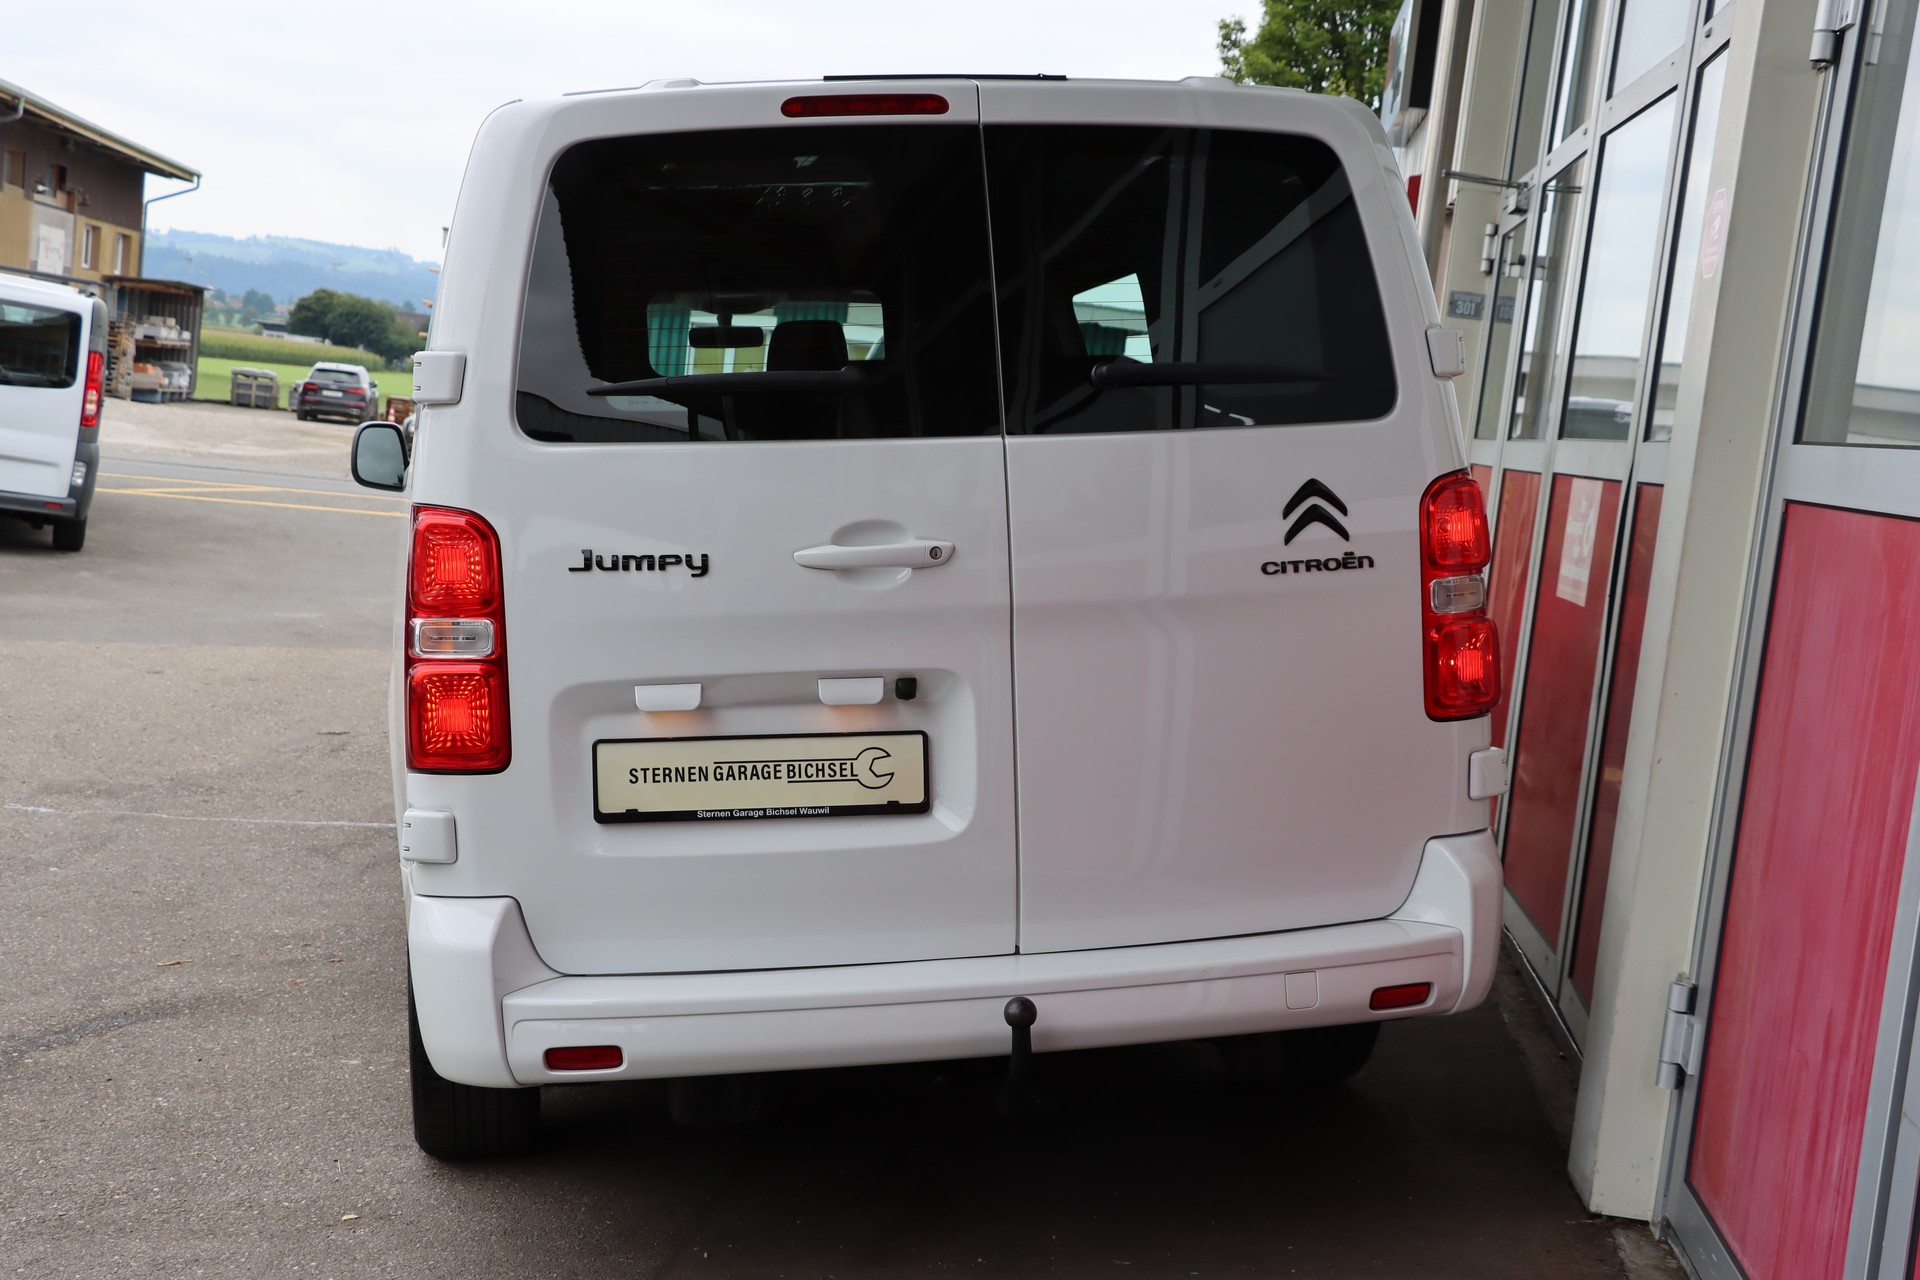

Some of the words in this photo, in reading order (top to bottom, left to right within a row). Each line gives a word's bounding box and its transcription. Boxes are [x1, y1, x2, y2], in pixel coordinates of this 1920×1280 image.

[1455, 300, 1476, 316] 301
[568, 549, 709, 578] Jumpy
[628, 766, 709, 784] STERNEN
[713, 763, 782, 781] GARAGE
[786, 762, 859, 779] BICHSEL
[697, 810, 731, 818] Sternen
[733, 809, 763, 818] Garage
[766, 808, 798, 816] Bichsel
[799, 806, 830, 815] Wauwil
